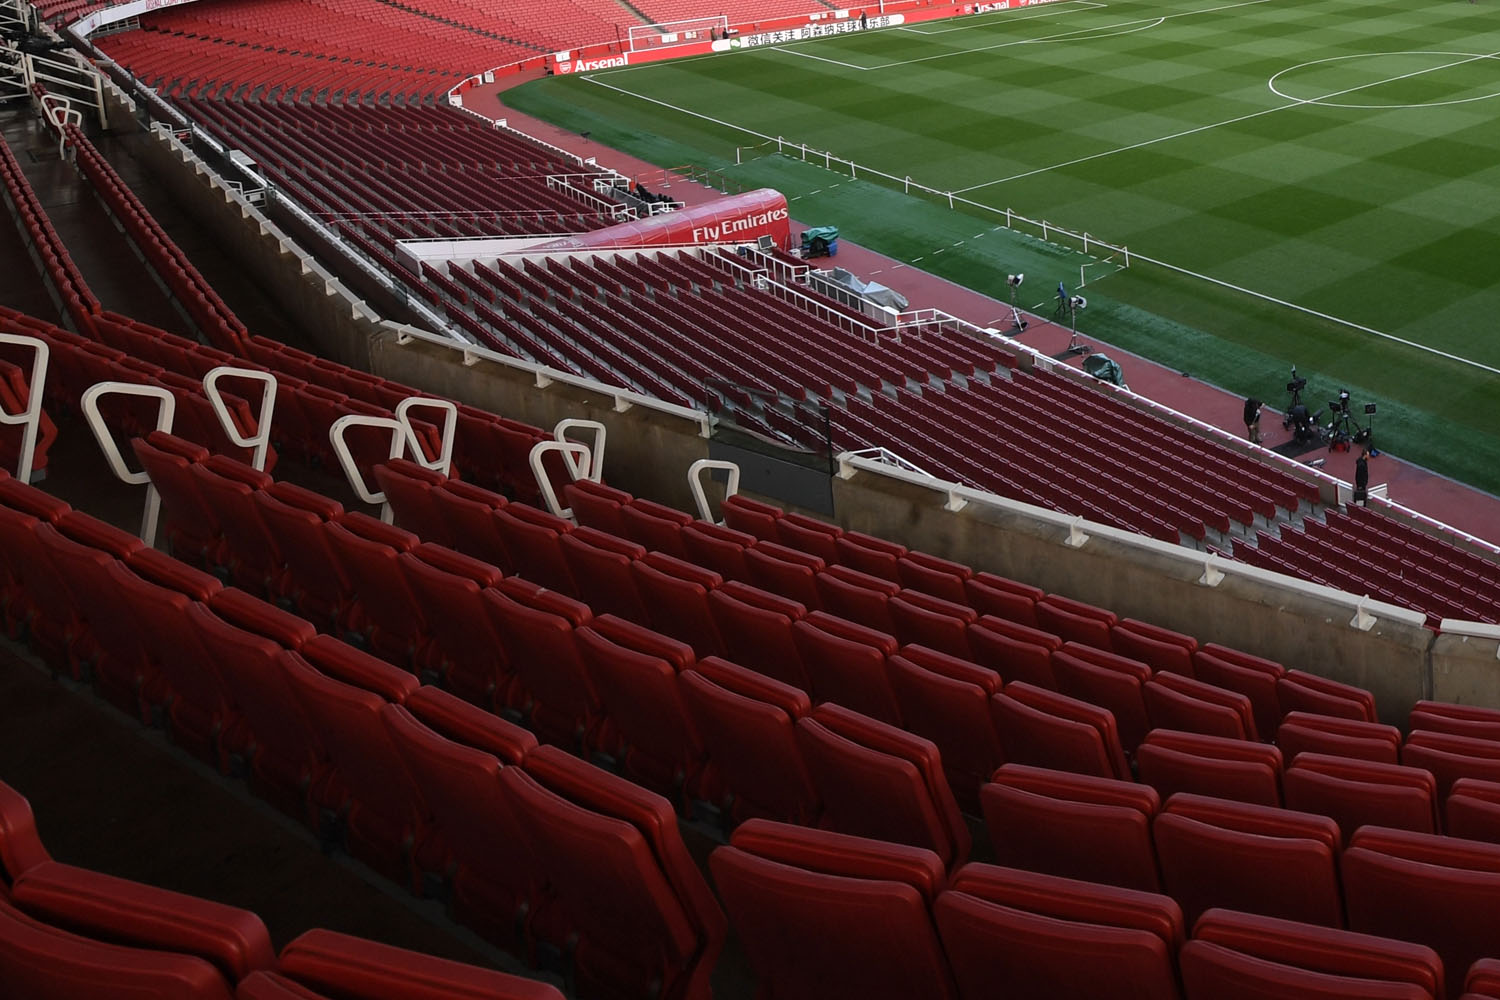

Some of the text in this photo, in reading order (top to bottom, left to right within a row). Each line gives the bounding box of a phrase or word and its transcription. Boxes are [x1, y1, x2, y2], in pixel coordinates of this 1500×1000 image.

[748, 30, 795, 46] 微信关注
[574, 53, 628, 73] Arsenal
[693, 208, 788, 242] Fly Emirates
